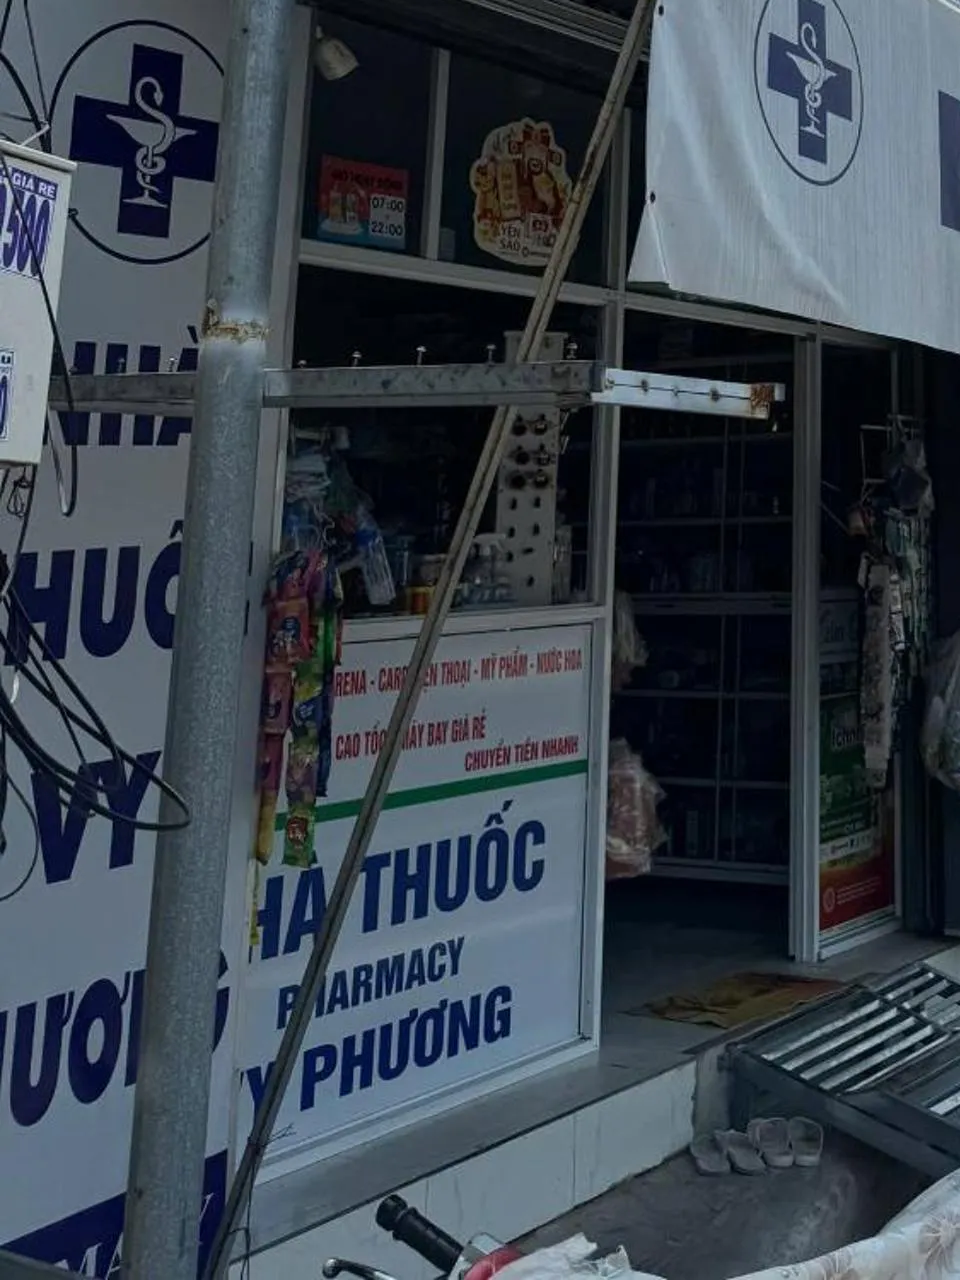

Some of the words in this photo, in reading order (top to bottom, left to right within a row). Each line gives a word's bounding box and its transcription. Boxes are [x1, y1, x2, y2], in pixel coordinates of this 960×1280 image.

[335, 732, 361, 760] CAO
[427, 722, 447, 746] BAY
[464, 738, 511, 771] CHUYỂN
[541, 734, 579, 758] NHANH
[30, 750, 162, 885] VY
[361, 800, 546, 934] THUỐC
[299, 985, 513, 1112] PHƯƠNG
